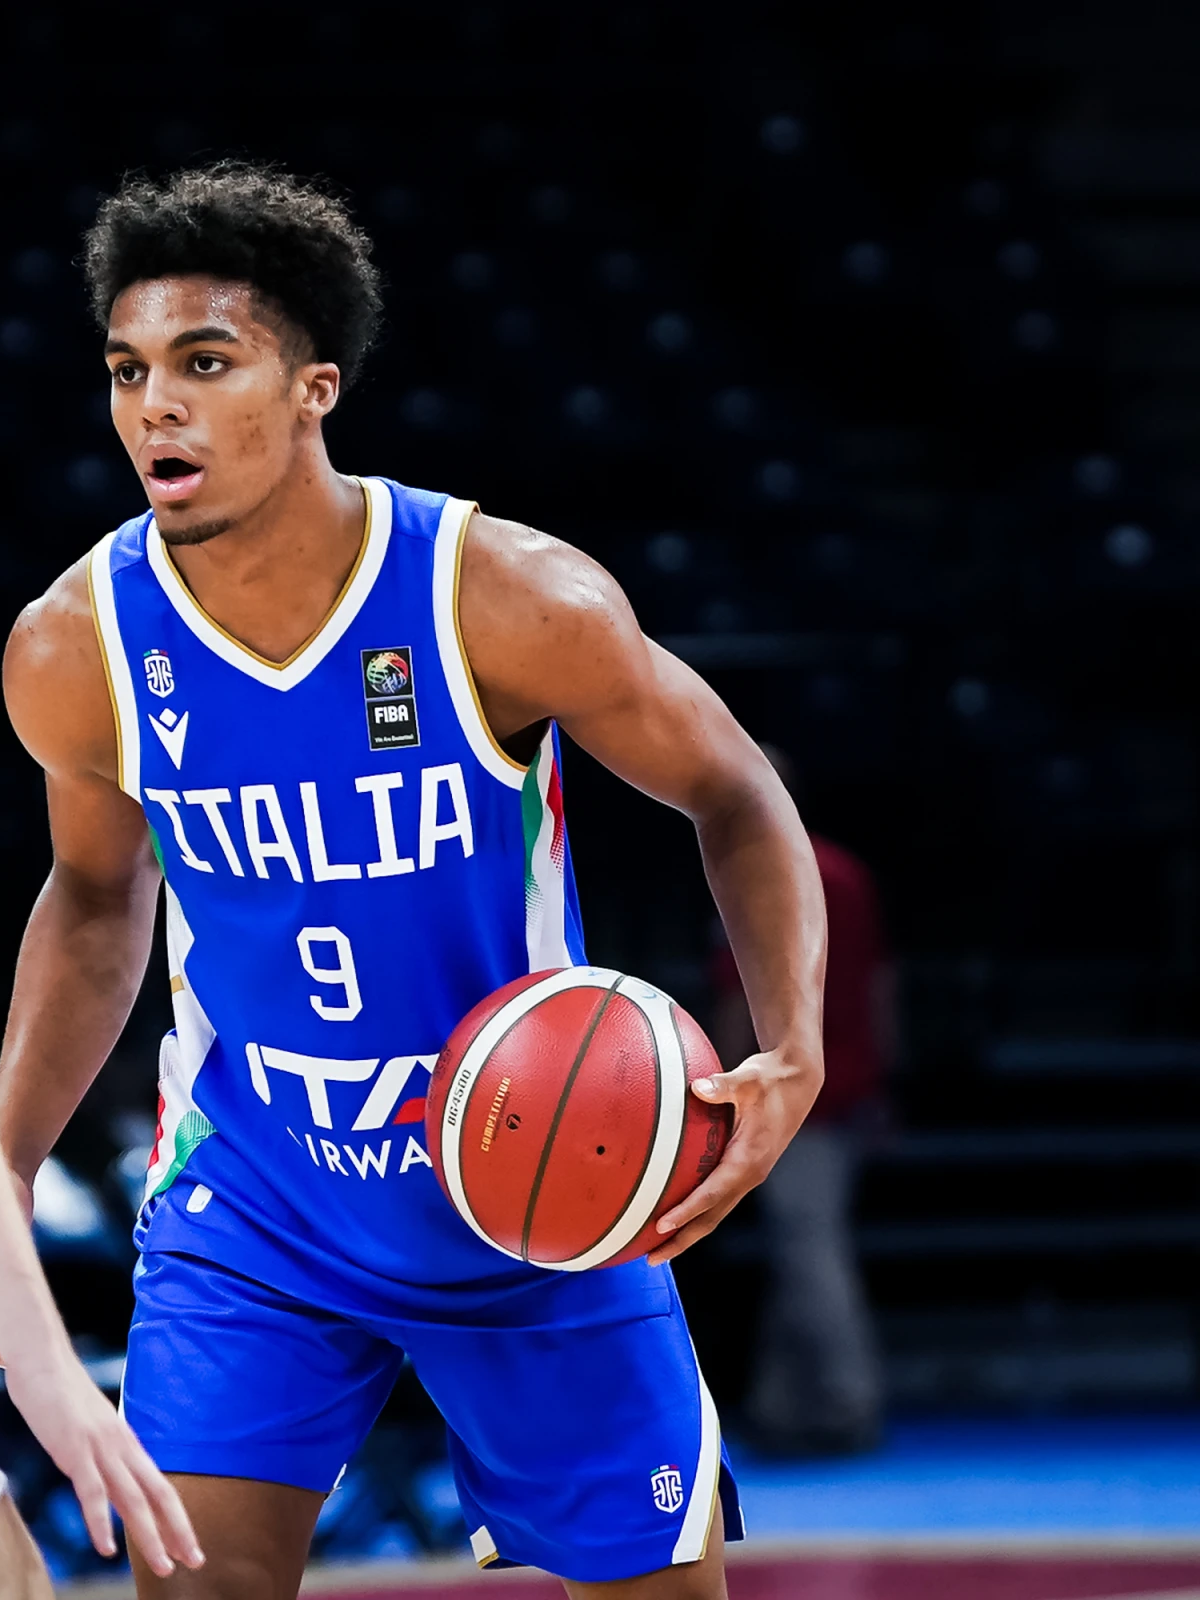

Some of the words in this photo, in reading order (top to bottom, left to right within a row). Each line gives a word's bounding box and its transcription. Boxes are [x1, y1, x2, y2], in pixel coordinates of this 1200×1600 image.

[374, 704, 409, 724] FIBA
[144, 762, 475, 883] ITALIA
[296, 926, 363, 1021] 9
[480, 1076, 512, 1152] COMPETITION
[506, 1114, 522, 1130] 7
[287, 1126, 433, 1180] IRWA
